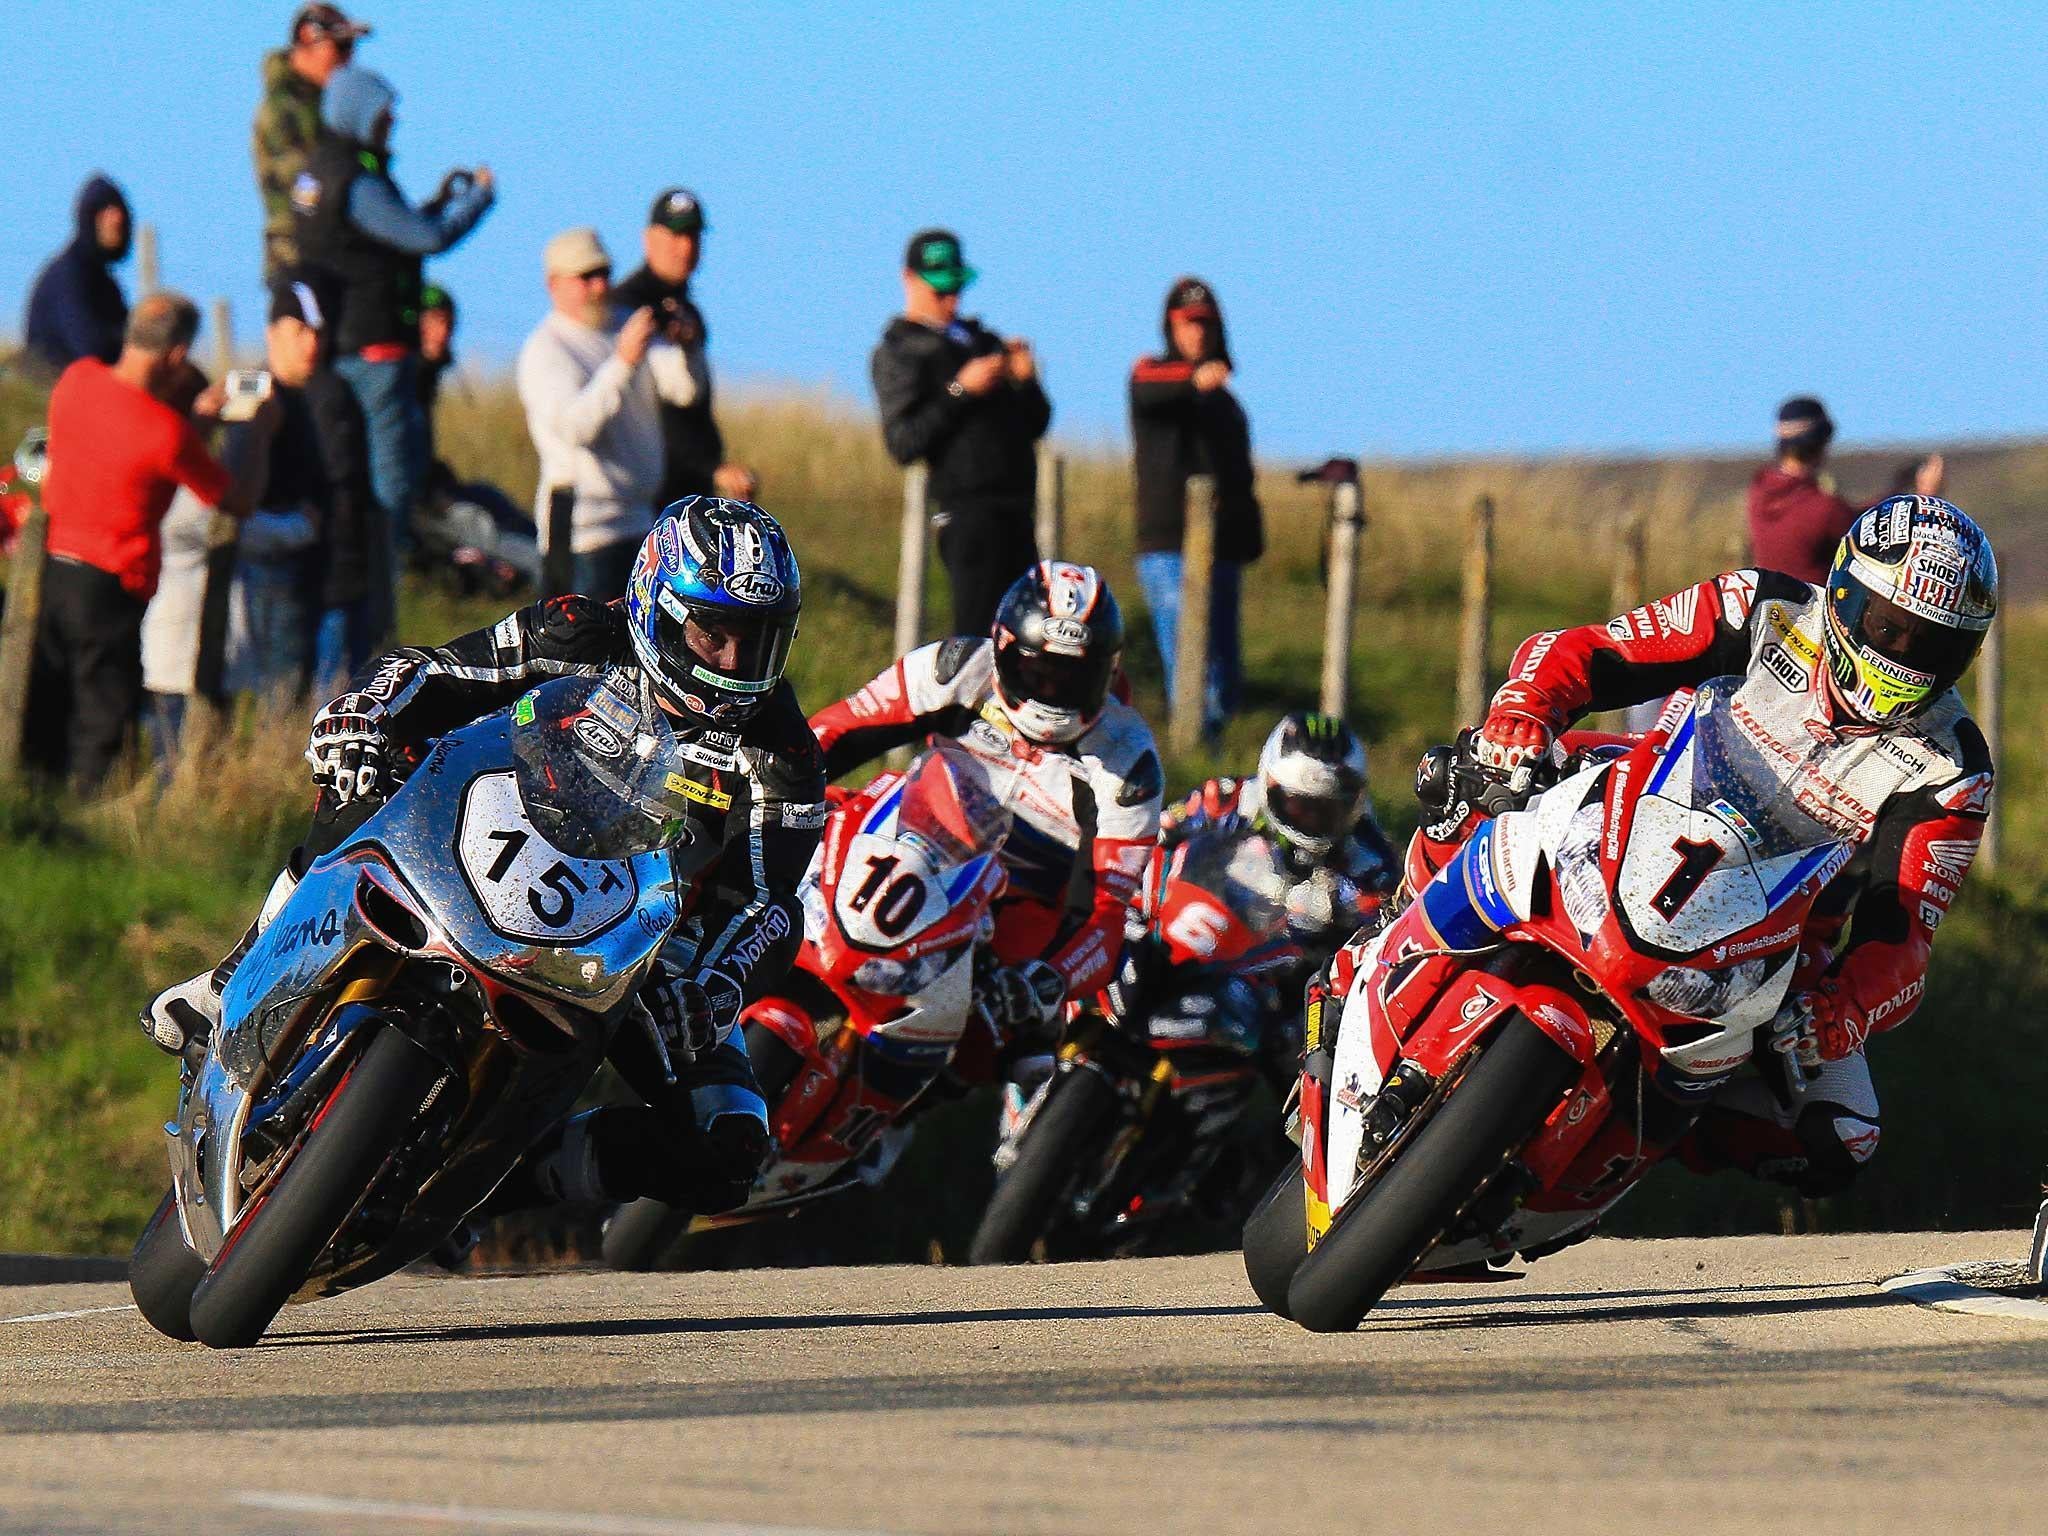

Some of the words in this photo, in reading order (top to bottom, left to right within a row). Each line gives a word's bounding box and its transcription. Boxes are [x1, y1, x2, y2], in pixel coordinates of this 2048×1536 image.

[730, 574, 778, 597] Arai
[1918, 559, 1958, 584] SHOEI
[1043, 619, 1085, 640] Arai
[1654, 600, 1672, 640] ONDA
[1915, 600, 1955, 625] bennetts
[1778, 623, 1820, 660] DUNLOP
[694, 667, 720, 686] CHASE
[1764, 647, 1805, 689] SHOEI
[1861, 650, 1933, 688] DENNISON
[1653, 690, 1692, 735] MOTUL
[585, 723, 617, 752] Arai
[1876, 734, 1927, 775] HITACHI
[677, 783, 726, 804] DUNLOP
[1802, 763, 1878, 825] Racing
[486, 829, 589, 929] 15
[1478, 836, 1497, 908] CBR
[1502, 848, 1518, 892] Racing
[1649, 835, 1727, 924] 1
[849, 853, 927, 938] 10
[721, 904, 791, 983] Norton
[1167, 901, 1229, 956] 6
